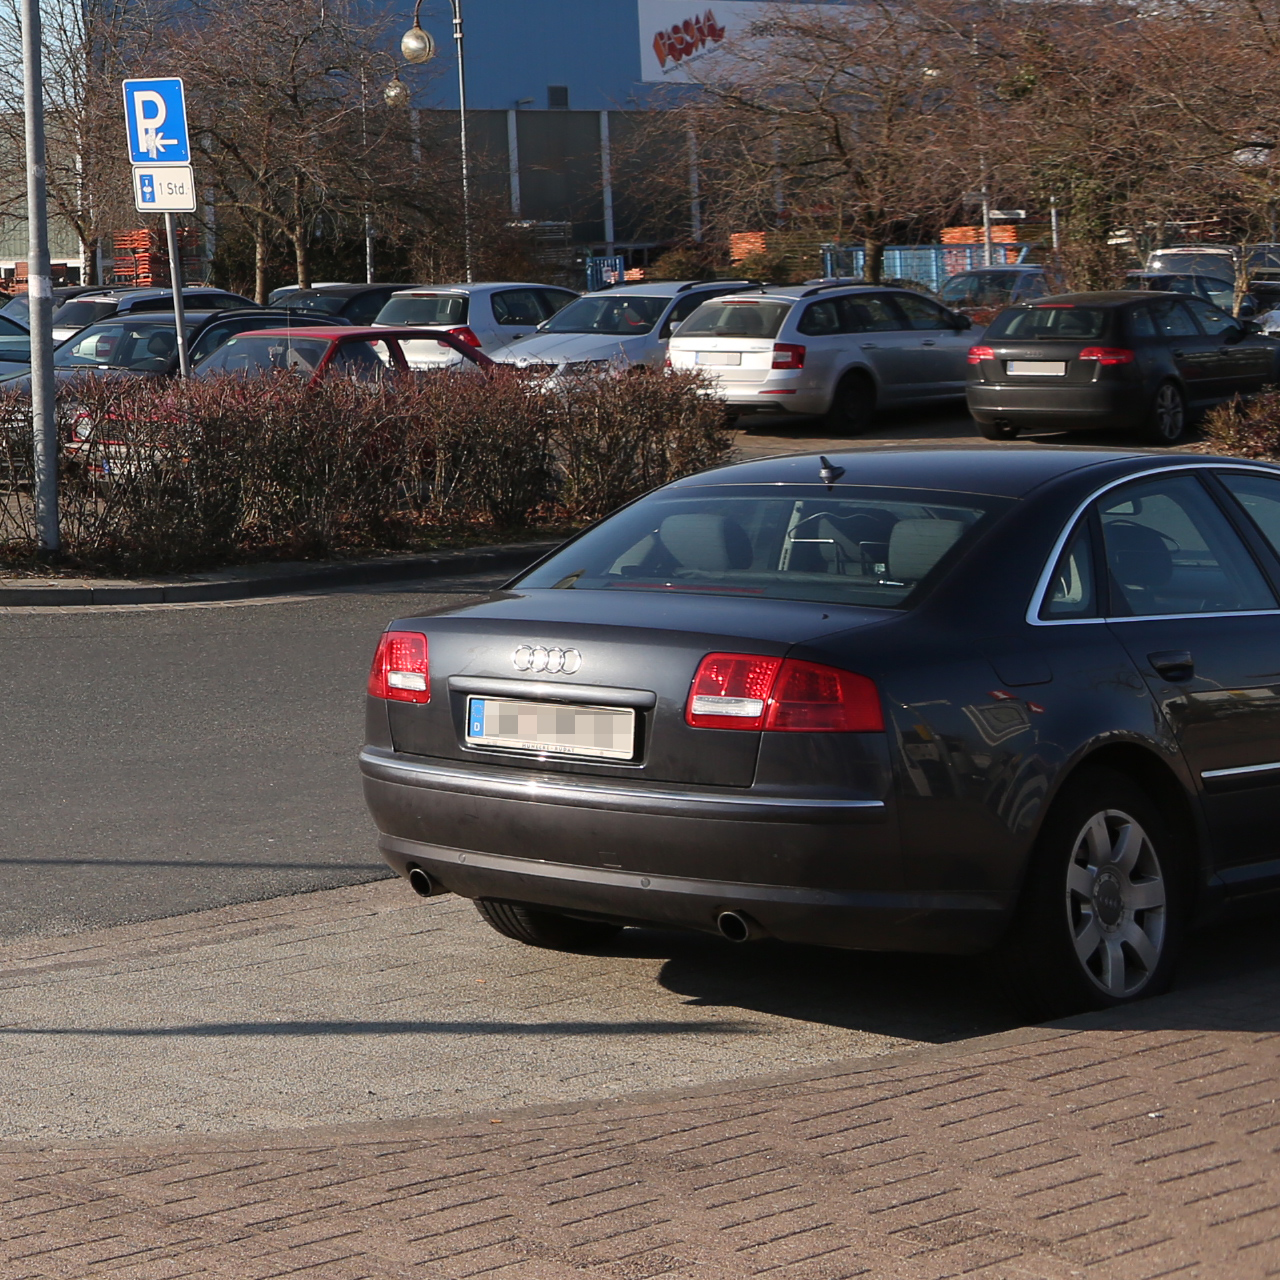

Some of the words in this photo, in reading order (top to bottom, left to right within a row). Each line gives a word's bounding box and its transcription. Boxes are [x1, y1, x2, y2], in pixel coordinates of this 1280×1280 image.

[134, 90, 167, 152] P
[158, 182, 164, 195] 1
[167, 182, 188, 196] Std.
[474, 722, 481, 731] D
